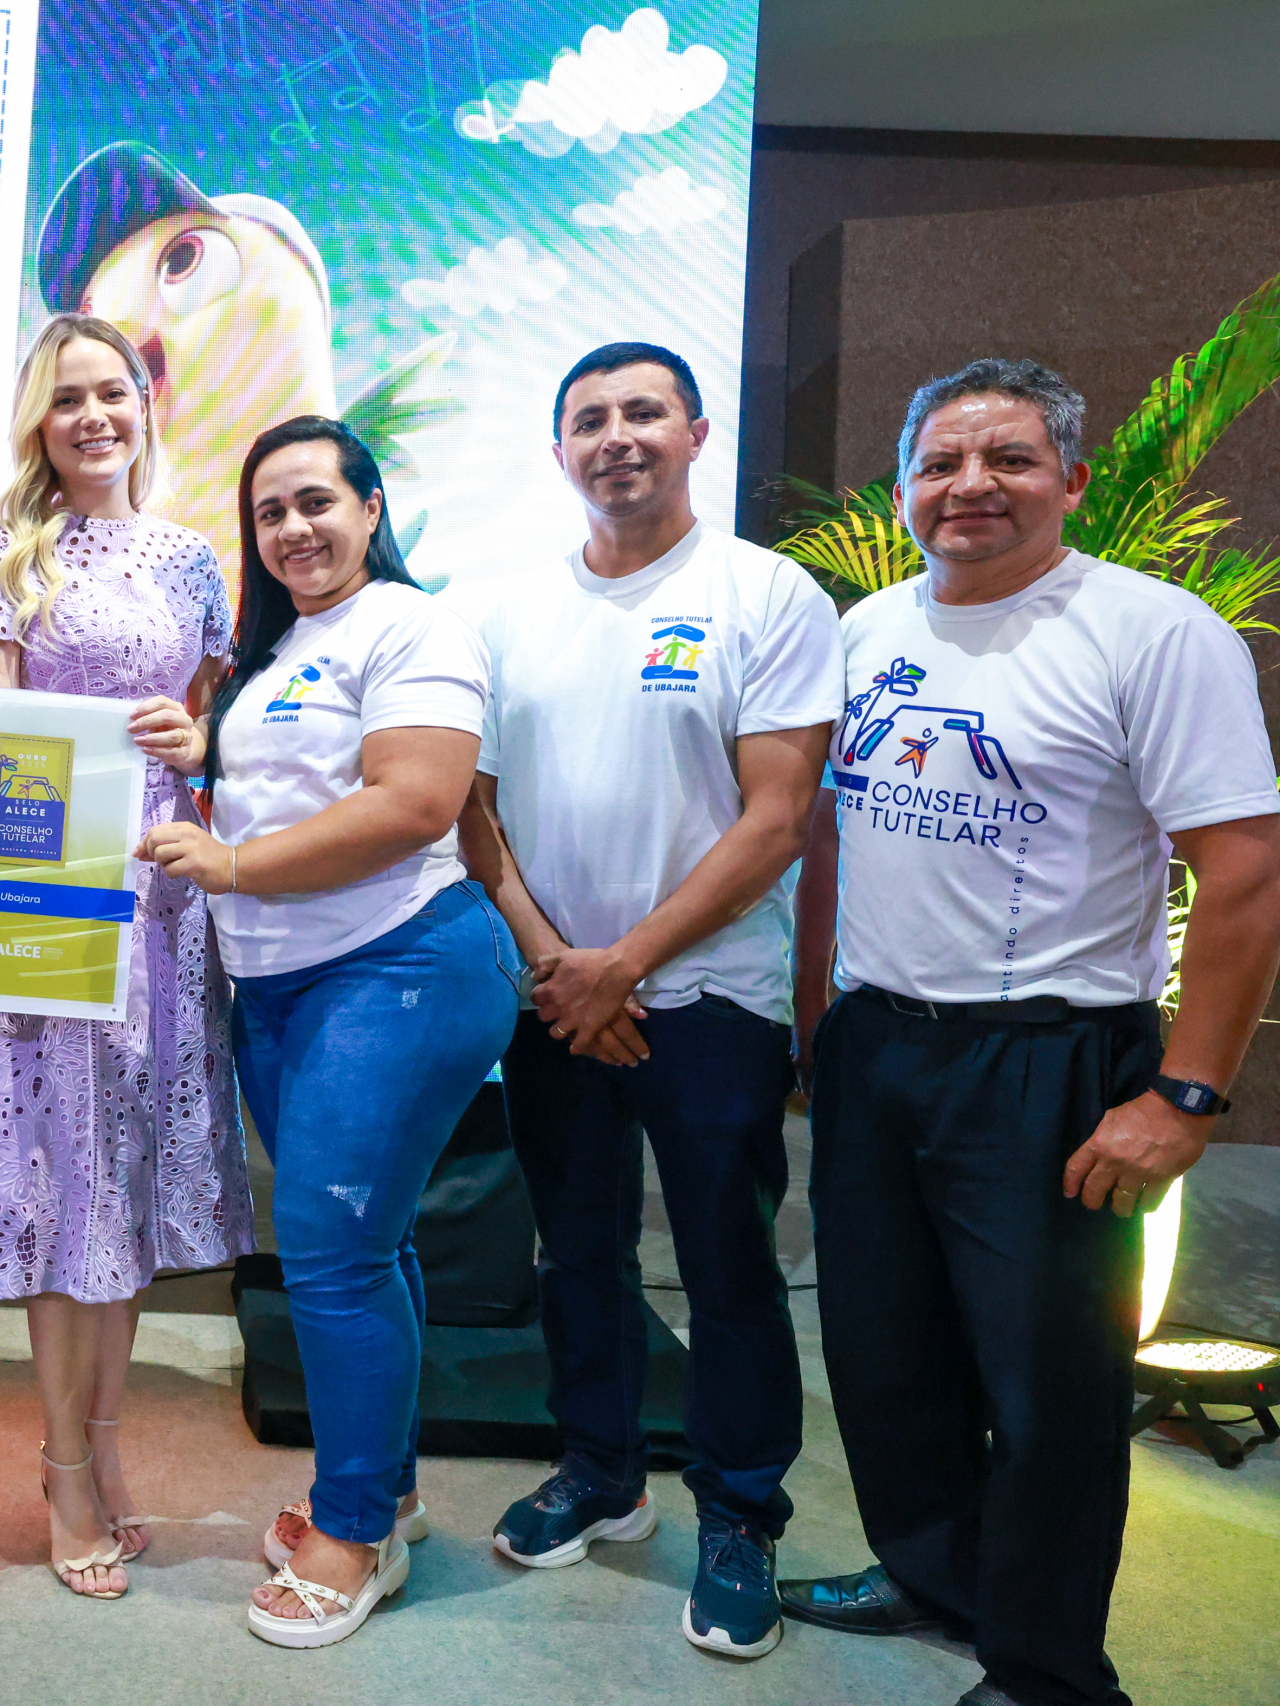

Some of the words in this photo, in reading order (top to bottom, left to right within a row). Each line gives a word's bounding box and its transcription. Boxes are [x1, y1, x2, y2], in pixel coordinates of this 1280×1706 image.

[651, 616, 684, 624] CONSELHO
[686, 615, 713, 624] TUTELAR
[641, 684, 653, 692] DE
[655, 683, 697, 693] UBAJARA
[269, 715, 299, 723] UBAJARA
[17, 753, 47, 762] OURO
[15, 799, 40, 807] SELO
[872, 780, 1048, 825] CONSELHO
[5, 806, 46, 817] ALECE
[869, 806, 1002, 848] TUTELAR
[2, 832, 46, 844] TUTELAR
[1009, 836, 1029, 915] direitos
[0, 892, 41, 904] Ubajara
